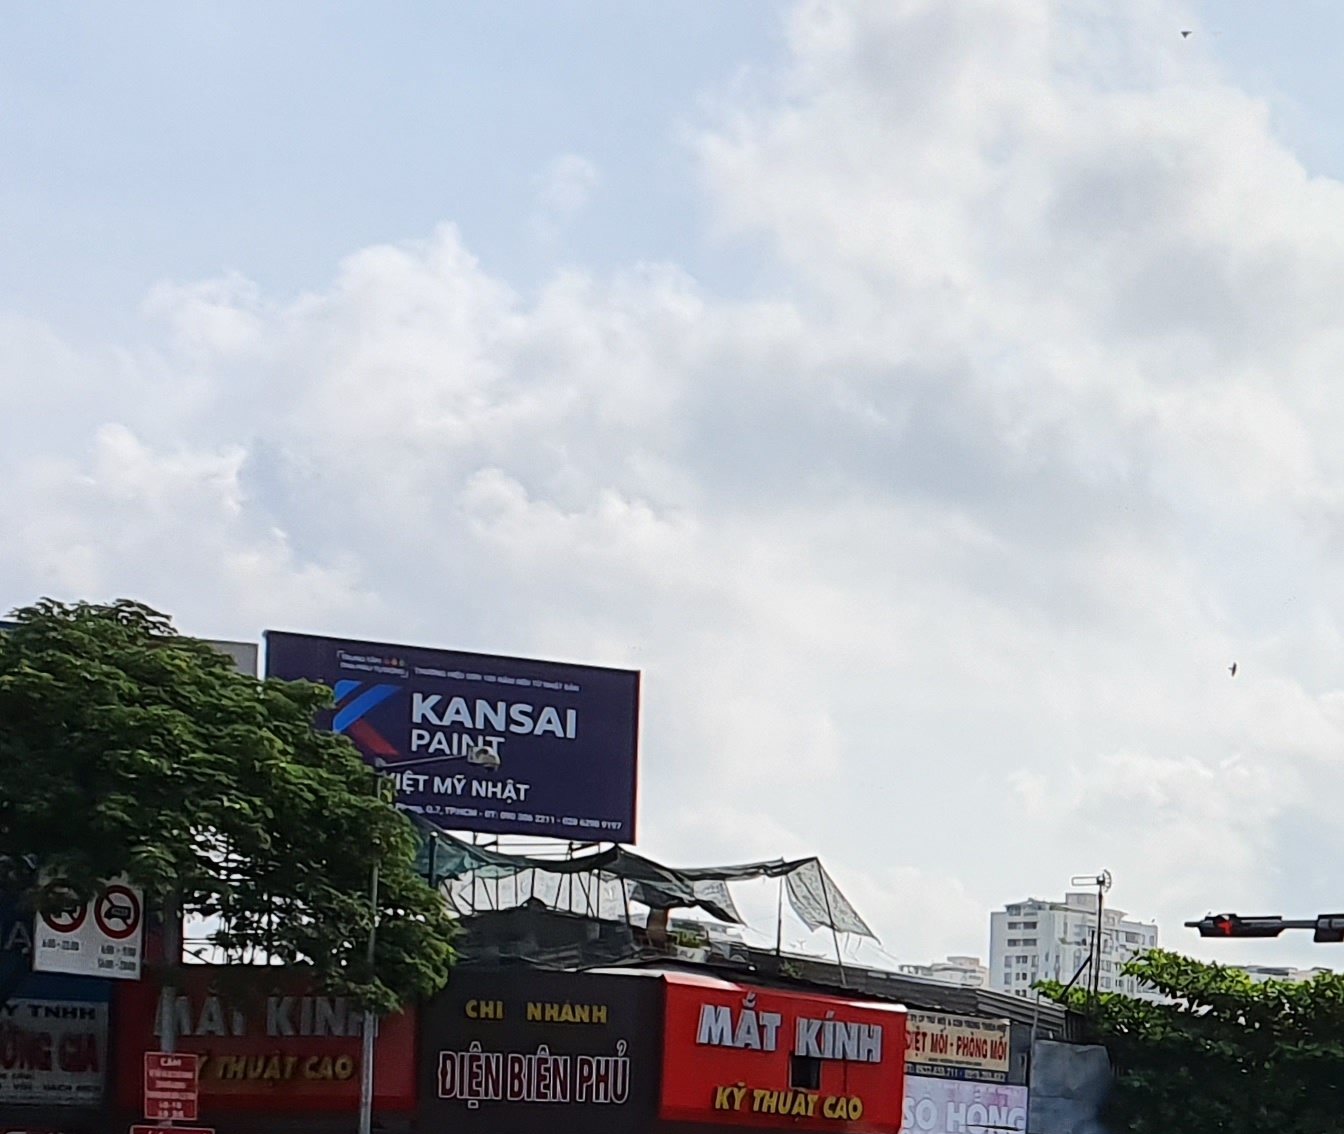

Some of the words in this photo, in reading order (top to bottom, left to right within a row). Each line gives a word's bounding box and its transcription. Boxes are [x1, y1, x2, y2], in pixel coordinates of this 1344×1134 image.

[411, 692, 578, 740] KANSAI
[410, 728, 506, 758] PAINT
[433, 774, 467, 796] MỸ
[471, 779, 531, 804] NHẬT
[465, 999, 504, 1020] CHI
[696, 991, 782, 1052] MẮT
[794, 1010, 883, 1064] KÍNH
[956, 1031, 988, 1060] PHÒNG
[303, 1055, 355, 1081] CAO
[437, 1041, 503, 1109] ĐIỆN
[507, 1044, 571, 1103] BIÊN
[576, 1039, 630, 1104] PHỦ
[753, 1087, 819, 1121] THUẬT
[823, 1095, 864, 1121] CAO
